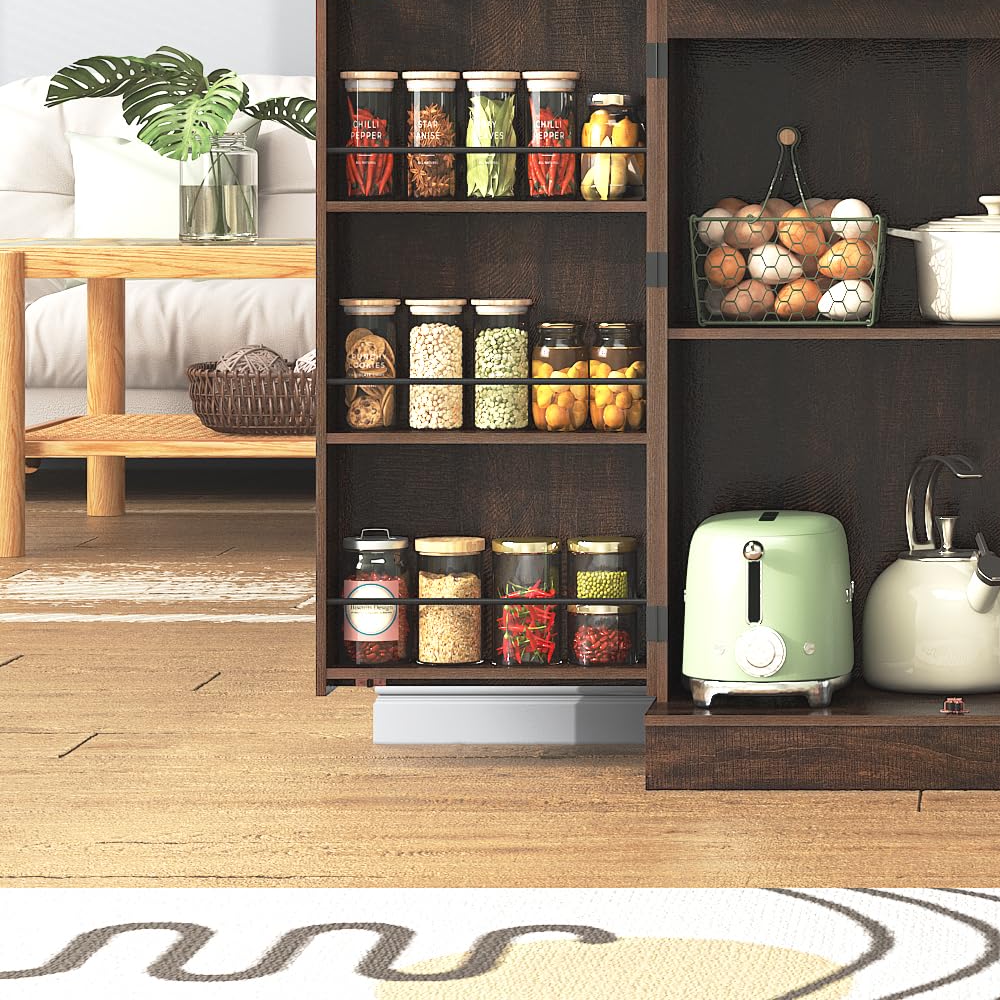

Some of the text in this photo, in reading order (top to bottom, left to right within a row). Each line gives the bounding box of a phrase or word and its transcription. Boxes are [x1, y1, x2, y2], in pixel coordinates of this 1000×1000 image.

[353, 120, 379, 128] CHILLI
[418, 120, 438, 128] STAR
[536, 120, 562, 128] CHILLI
[351, 132, 382, 140] PEPPER
[416, 132, 440, 140] ANISE
